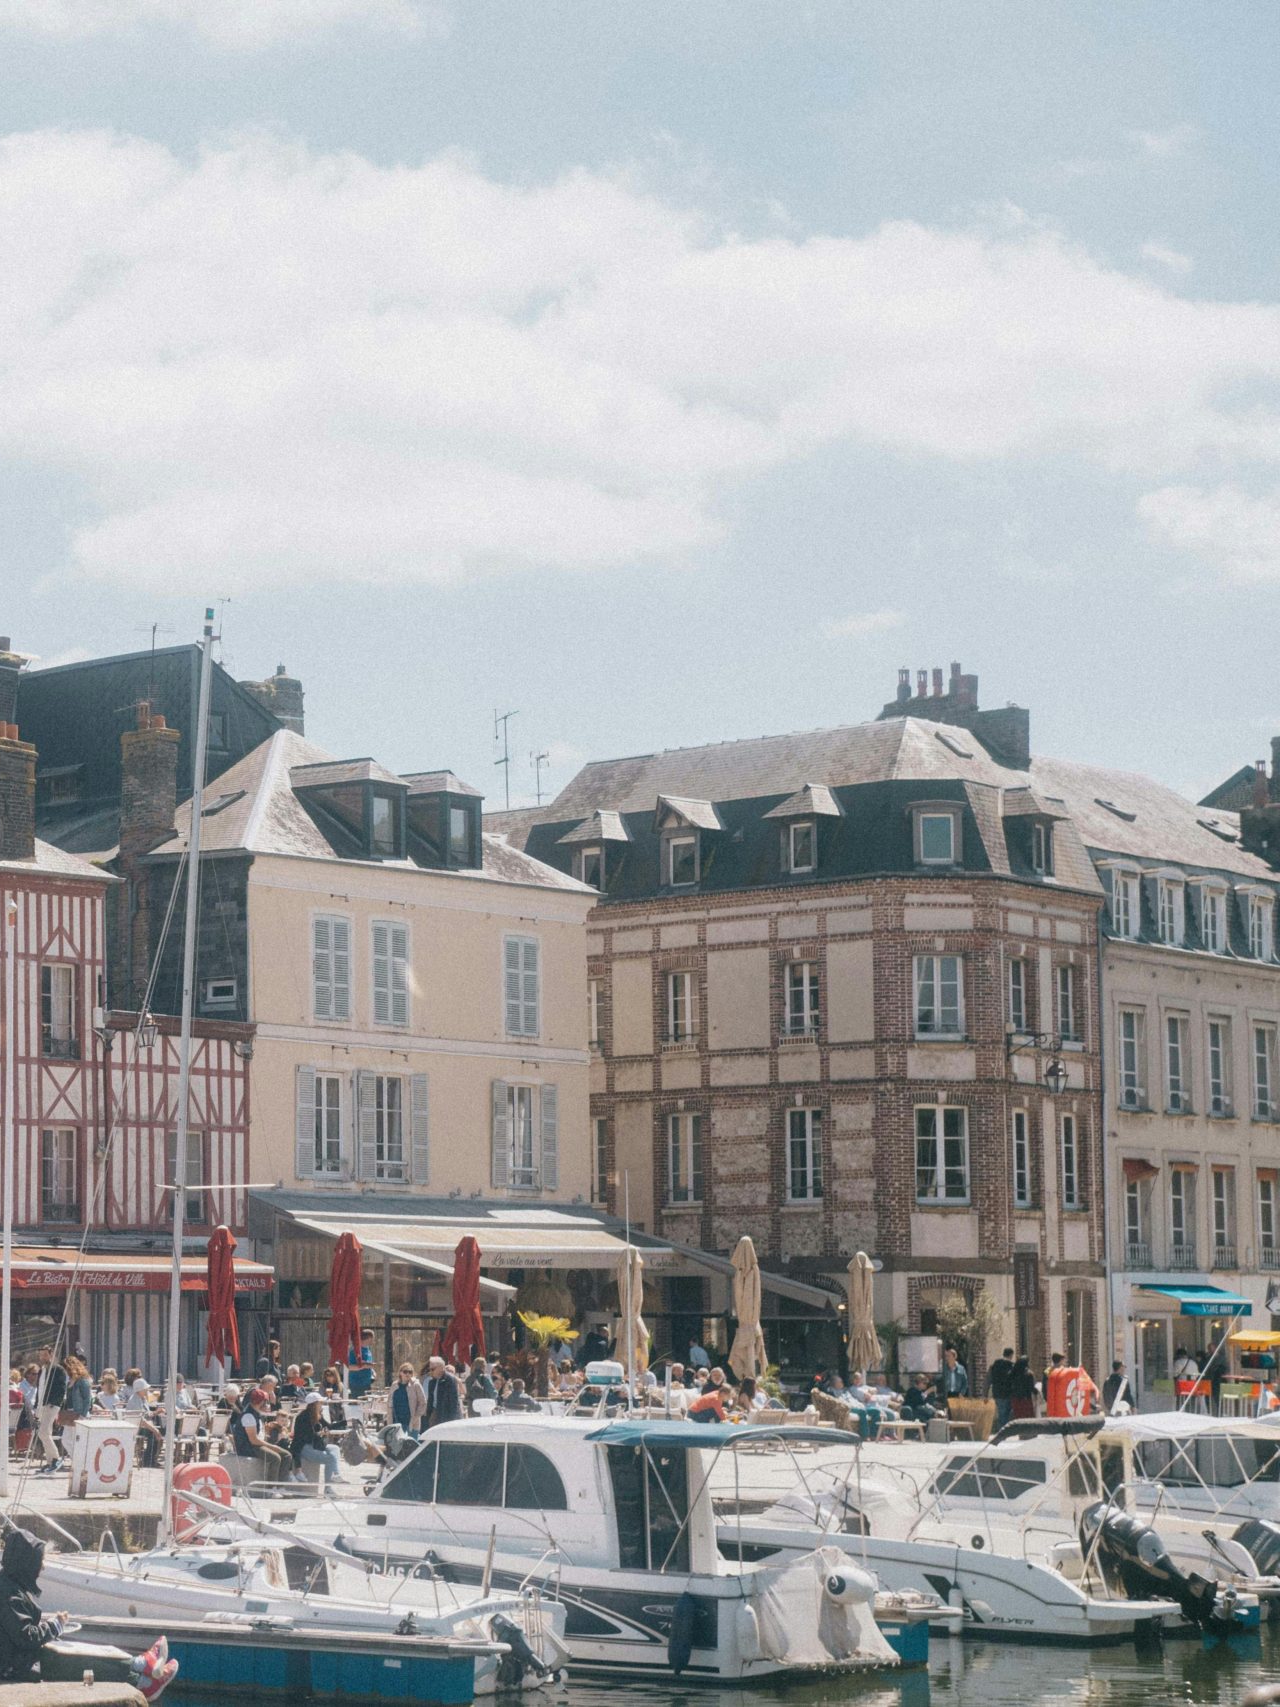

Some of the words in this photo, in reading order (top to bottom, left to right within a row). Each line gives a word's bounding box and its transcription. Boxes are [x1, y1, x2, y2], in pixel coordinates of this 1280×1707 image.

[27, 1271, 41, 1284] Le
[44, 1271, 70, 1284] Bistro
[113, 1273, 123, 1285] de
[125, 1273, 146, 1285] Ville
